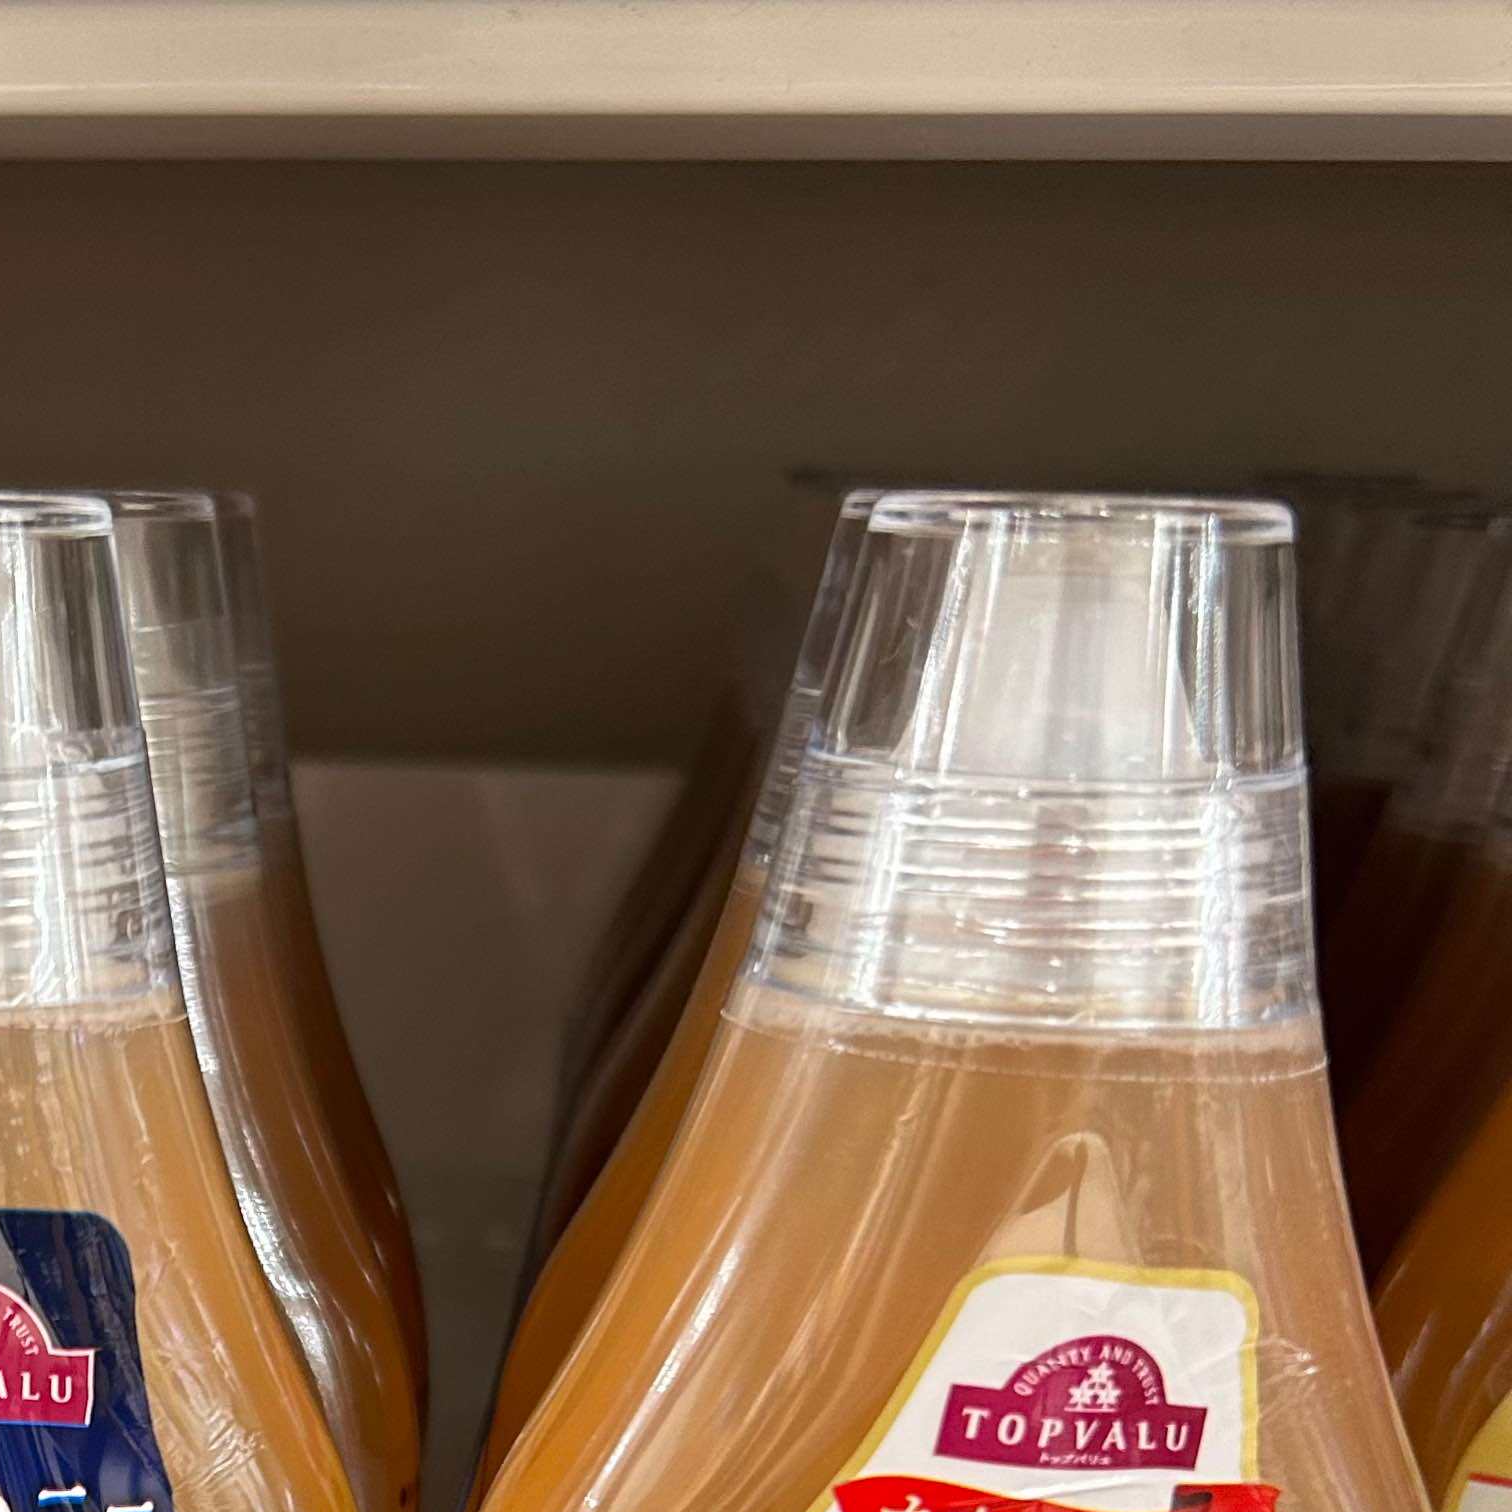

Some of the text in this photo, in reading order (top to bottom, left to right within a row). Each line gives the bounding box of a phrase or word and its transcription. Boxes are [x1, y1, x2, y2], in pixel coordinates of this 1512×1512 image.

[2, 1305, 39, 1357] TRUST
[1099, 1343, 1134, 1367] AND
[1131, 1357, 1160, 1406] TRUST
[961, 1407, 1188, 1452] TOPVALU
